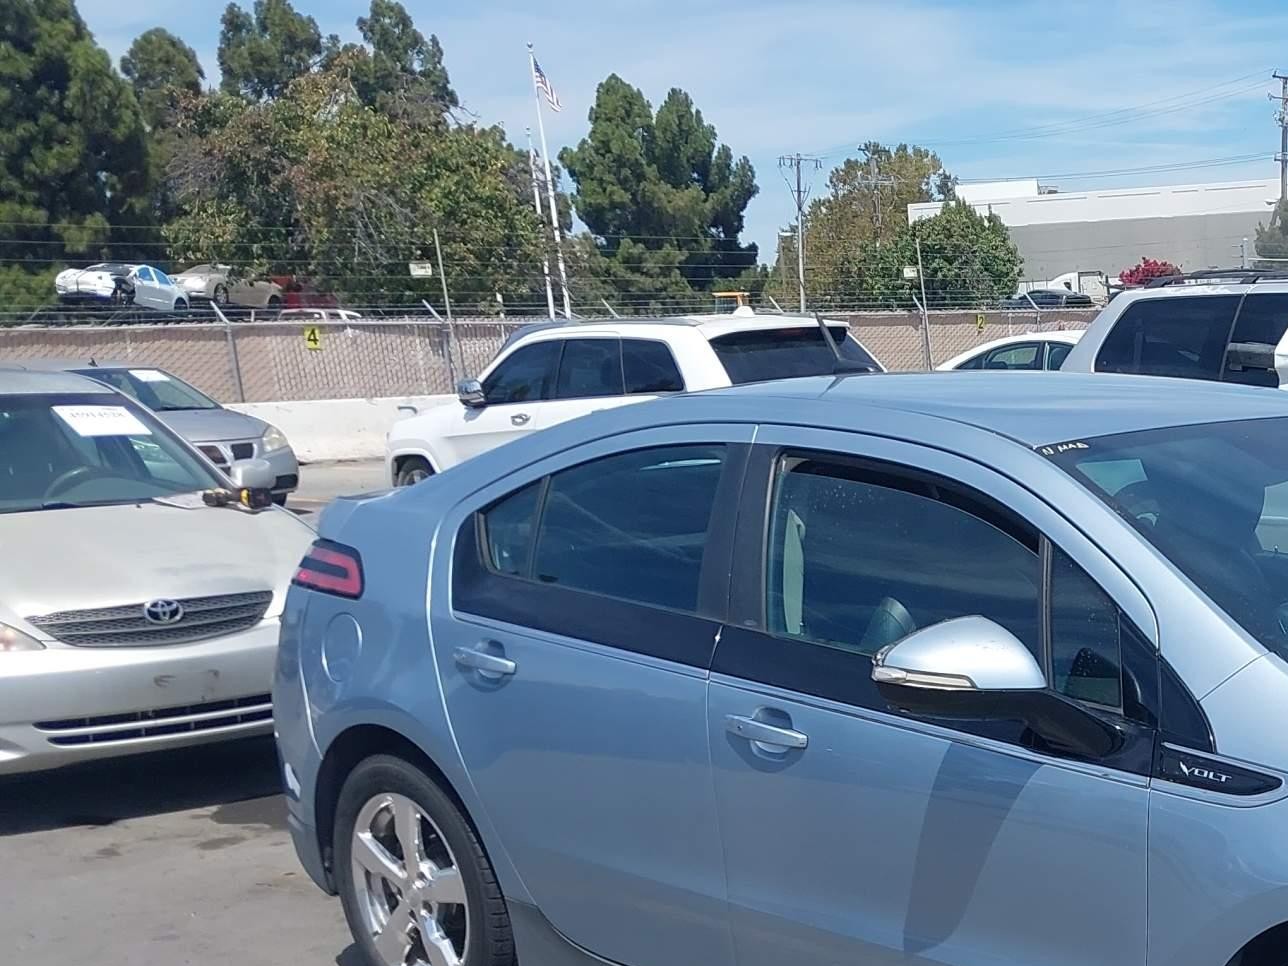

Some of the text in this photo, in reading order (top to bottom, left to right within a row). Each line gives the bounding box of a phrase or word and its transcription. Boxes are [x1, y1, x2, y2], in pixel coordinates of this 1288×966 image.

[978, 316, 985, 329] 2
[307, 327, 319, 345] 4
[1179, 761, 1232, 783] VOLT
